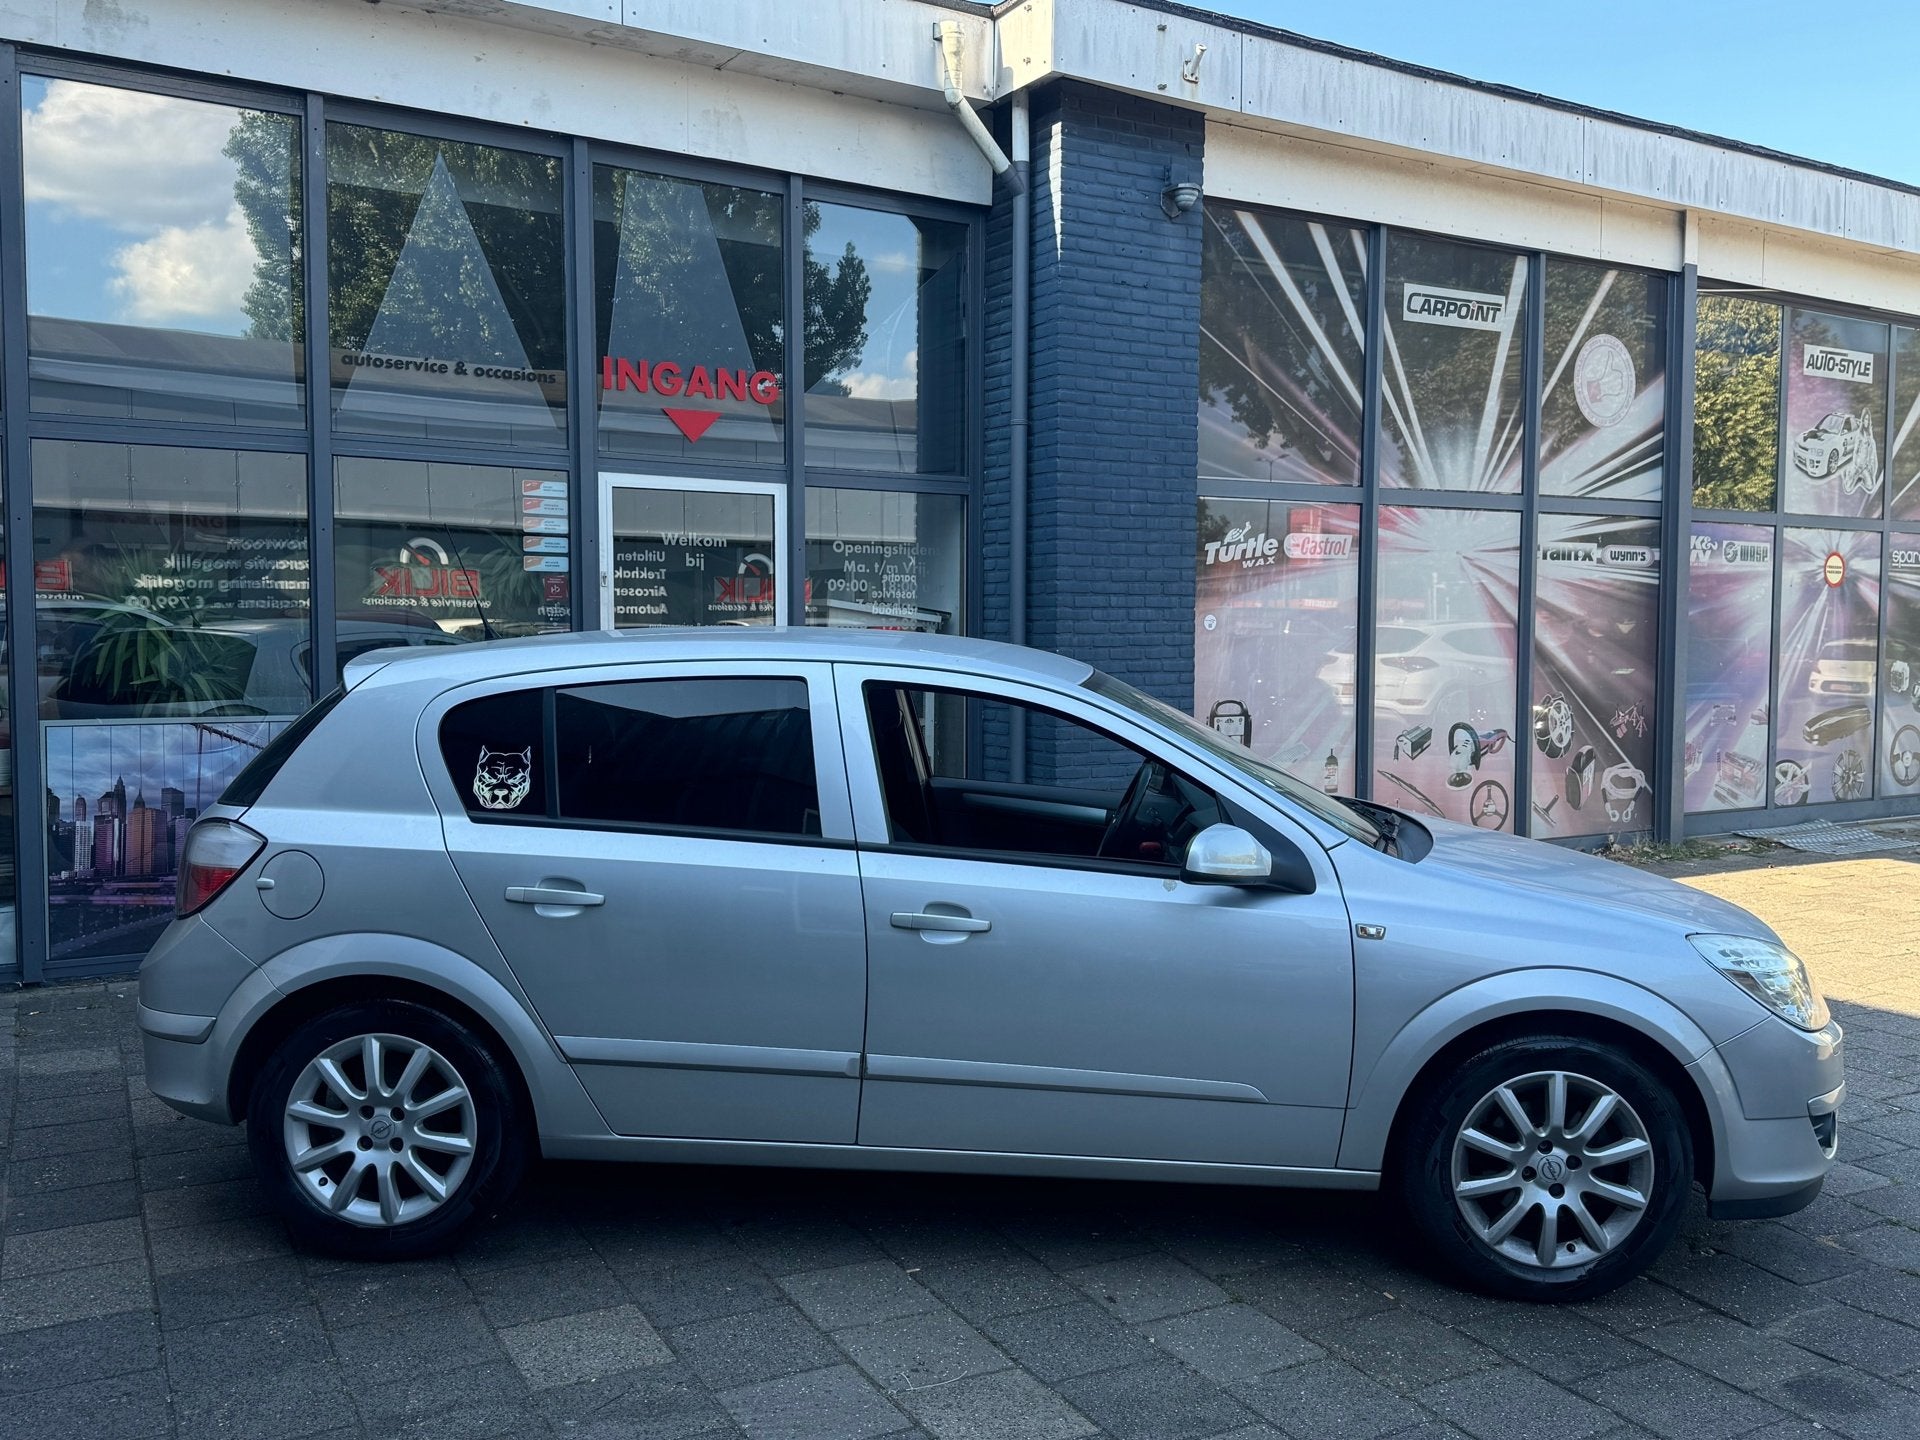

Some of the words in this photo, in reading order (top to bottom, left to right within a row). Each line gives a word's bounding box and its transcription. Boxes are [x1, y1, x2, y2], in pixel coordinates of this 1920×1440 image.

[341, 353, 448, 374] autoservice
[454, 361, 468, 376] &
[474, 365, 556, 384] occasions
[1806, 350, 1871, 378] AUTO-STYLE
[603, 356, 779, 405] INGANG
[661, 531, 728, 548] Welkom
[1301, 536, 1347, 556] Castrol
[1205, 533, 1279, 565] Turtle
[1740, 545, 1768, 562] WASP
[685, 552, 705, 570] bij
[843, 560, 870, 573] Ma.
[874, 560, 899, 575] t/m
[1242, 556, 1275, 568] WAX
[1892, 550, 1920, 568] spar
[828, 579, 868, 591] 09:00
